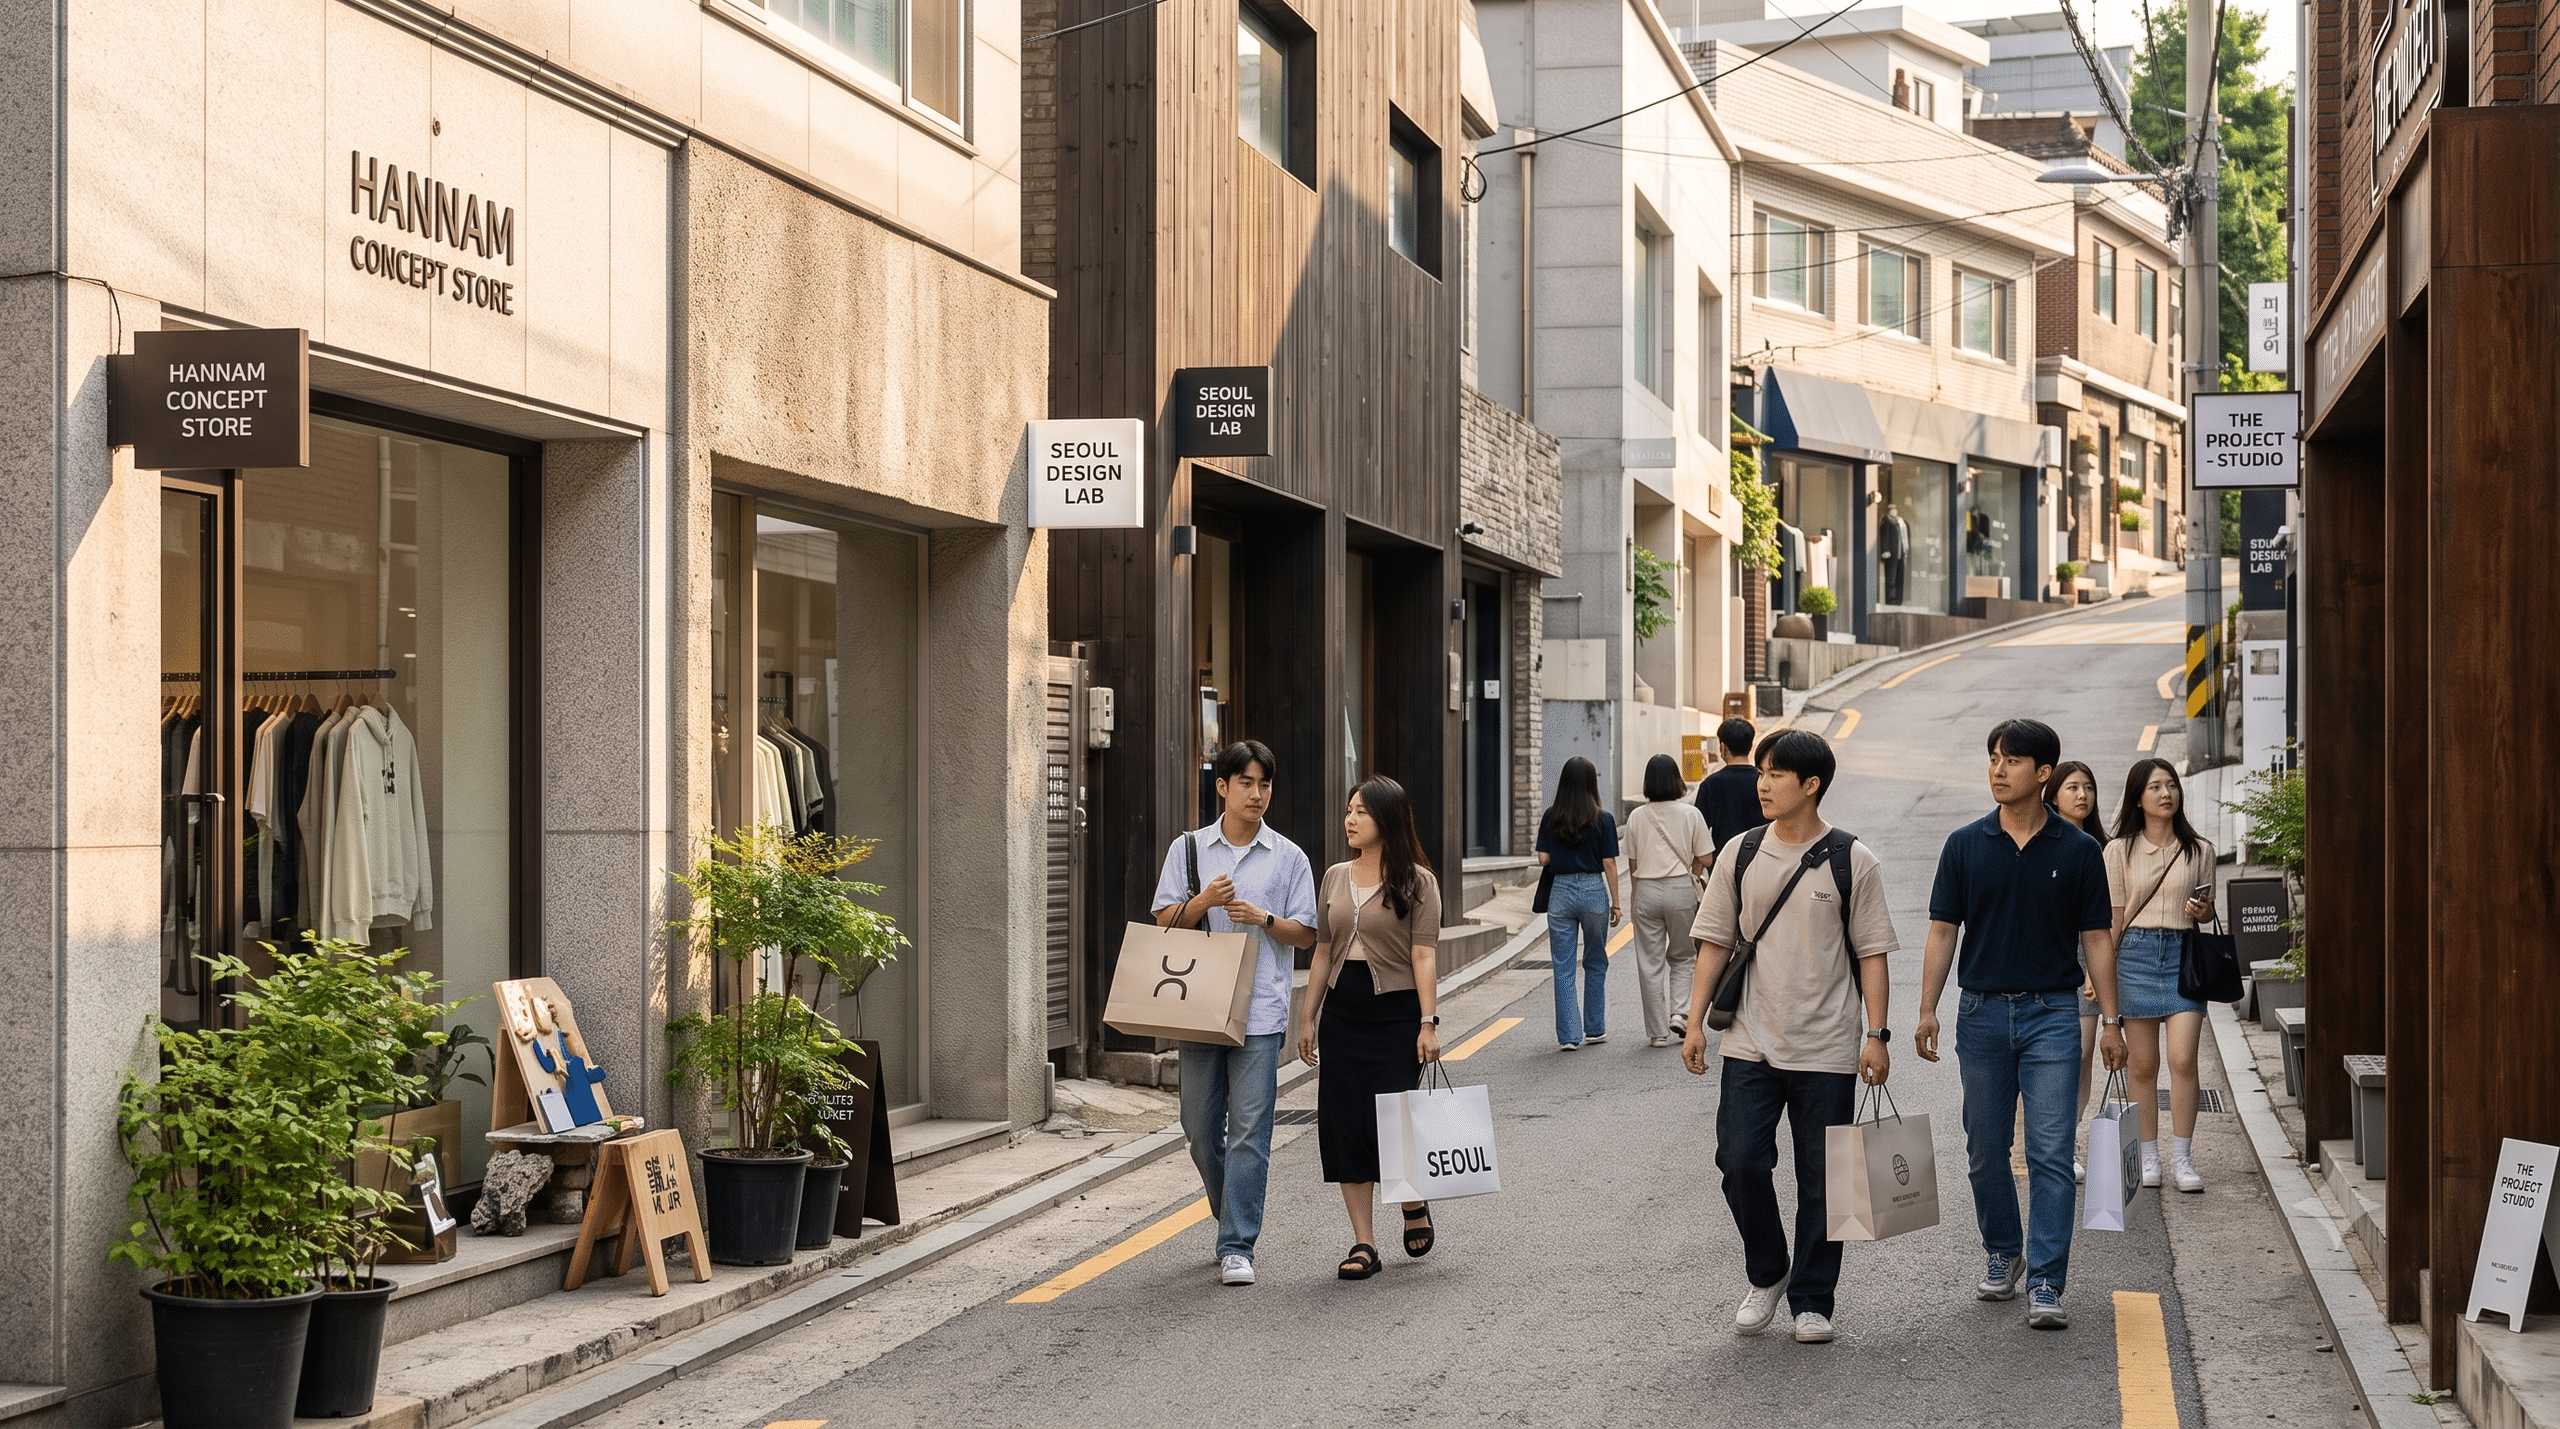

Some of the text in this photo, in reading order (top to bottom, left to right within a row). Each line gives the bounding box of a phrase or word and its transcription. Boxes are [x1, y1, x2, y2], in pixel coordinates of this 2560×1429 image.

[351, 150, 514, 266] HANNAM
[350, 235, 514, 316] CONCEPT STORE
[169, 363, 265, 383] HANNAM
[166, 389, 268, 411] CONCEPT
[1198, 386, 1253, 401] SEOUL
[1196, 404, 1256, 418] DESIGN
[181, 417, 252, 437] STORE
[1210, 421, 1242, 435] LAB
[2228, 413, 2263, 427] THE
[2206, 432, 2285, 447] PROJECT
[1050, 442, 1119, 459] SEOUL
[2217, 452, 2284, 467] STUDIO
[1046, 465, 1122, 481] DESIGN
[1065, 488, 1104, 504] LAB
[2250, 562, 2273, 573] LAB
[1427, 1146, 1492, 1177] SEOUL
[2517, 1163, 2534, 1176] THE
[2501, 1176, 2543, 1193] PROJECT
[2502, 1192, 2535, 1209] STUDIO
